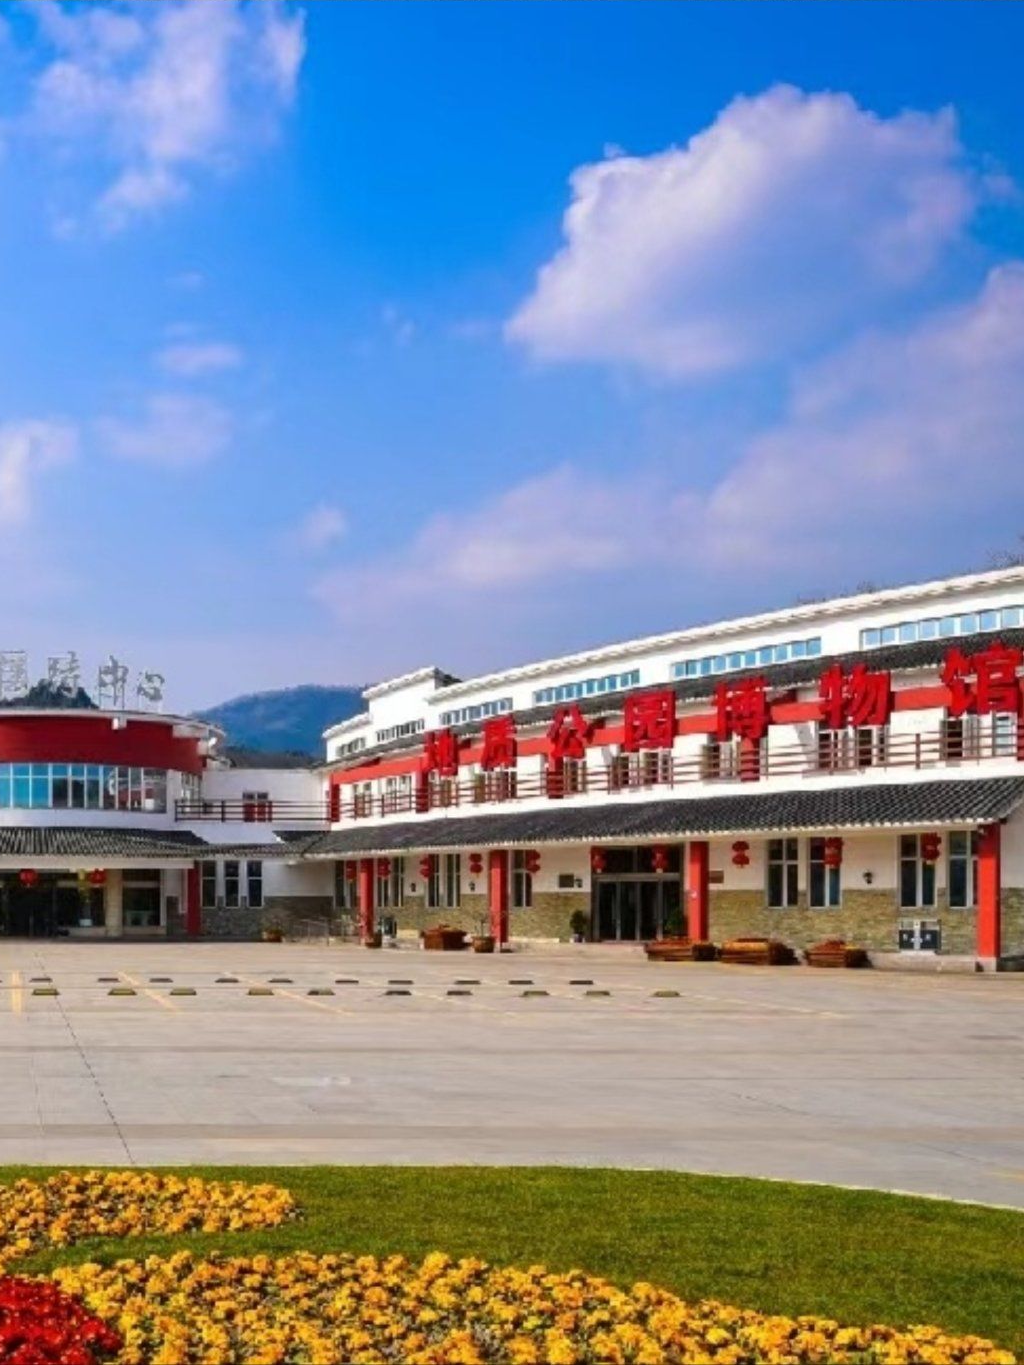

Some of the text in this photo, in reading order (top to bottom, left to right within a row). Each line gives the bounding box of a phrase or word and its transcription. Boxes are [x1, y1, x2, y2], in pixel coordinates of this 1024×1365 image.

[423, 638, 1021, 776] 地质公园博物馆
